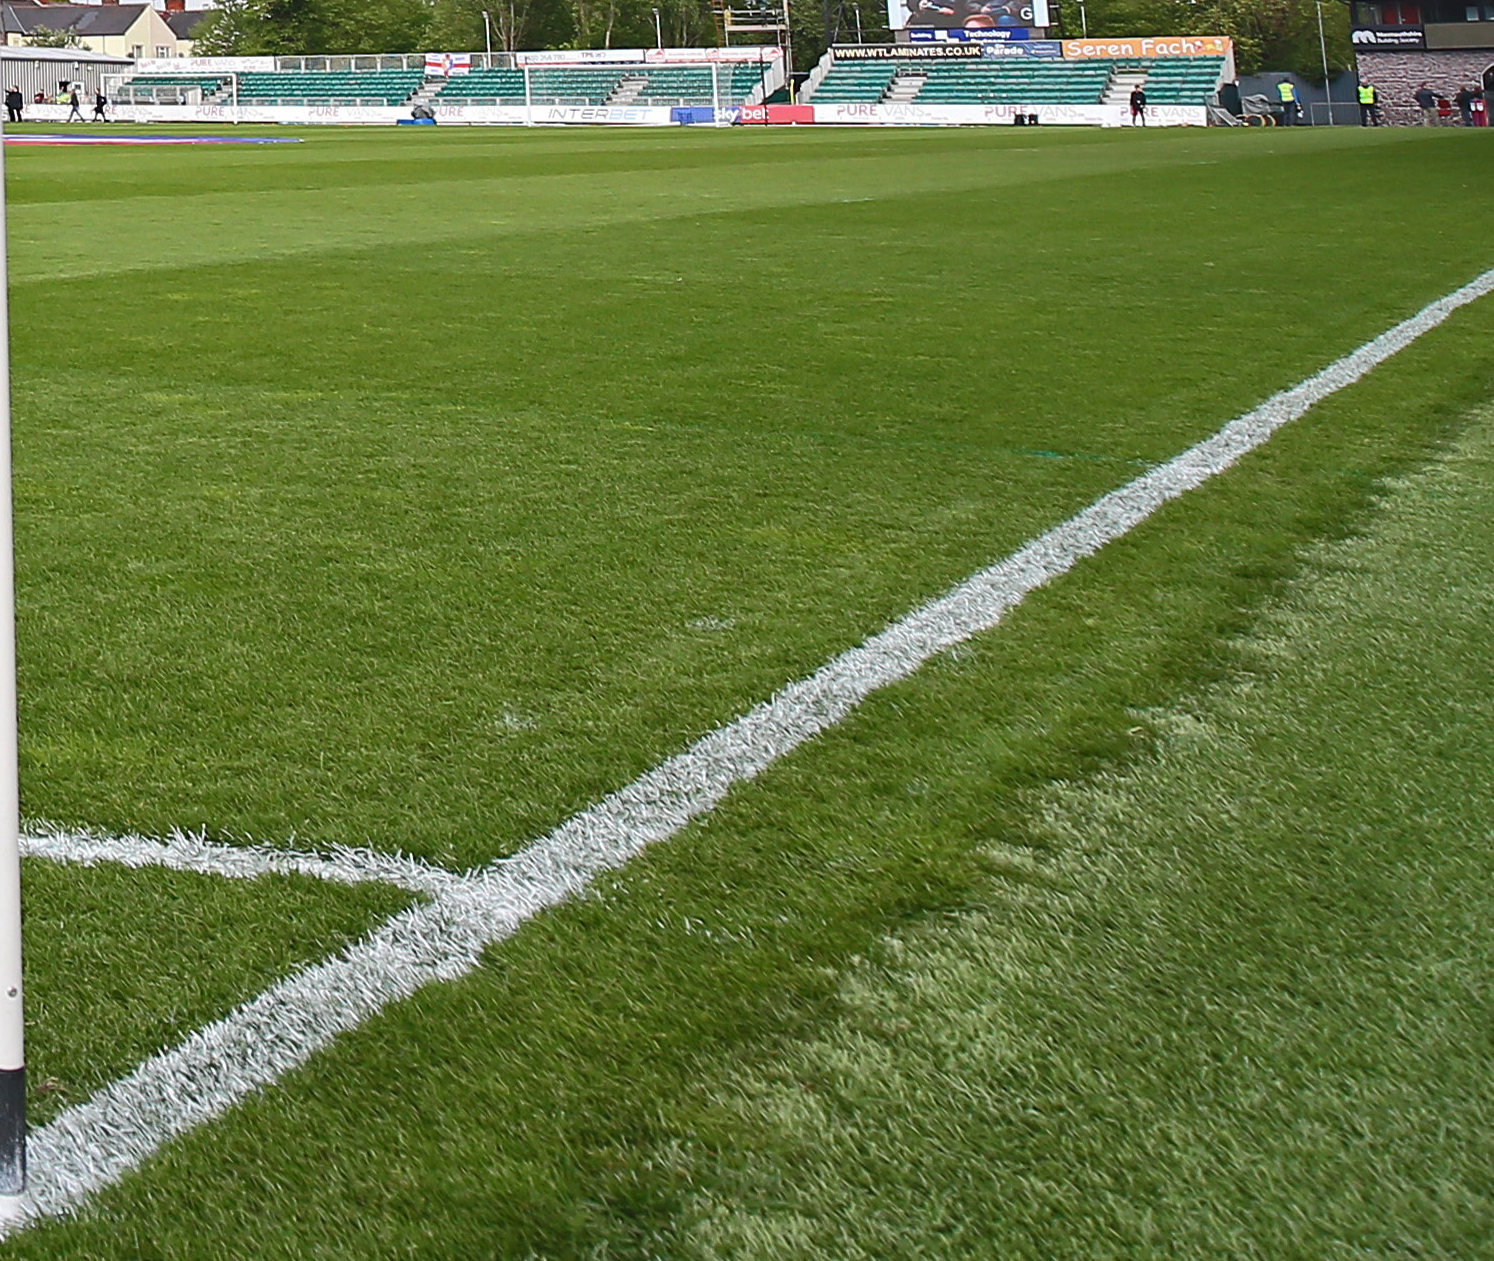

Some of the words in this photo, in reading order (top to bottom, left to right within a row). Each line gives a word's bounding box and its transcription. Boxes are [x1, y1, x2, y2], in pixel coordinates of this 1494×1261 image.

[1020, 7, 1033, 20] G
[964, 30, 1011, 39] Technology
[834, 46, 982, 58] WWW.WTLAMINATES.CO.UK
[1067, 42, 1133, 56] Seren
[1141, 38, 1195, 55] Fach
[195, 106, 225, 116] PURE
[308, 106, 339, 117] PURE
[548, 108, 652, 120] INTERBET
[837, 105, 878, 116] PURE
[883, 105, 925, 116] VANS
[984, 105, 1028, 118] PURE
[1033, 105, 1077, 118] VANS
[1120, 106, 1159, 118] PRE
[1162, 106, 1200, 118] VANS
